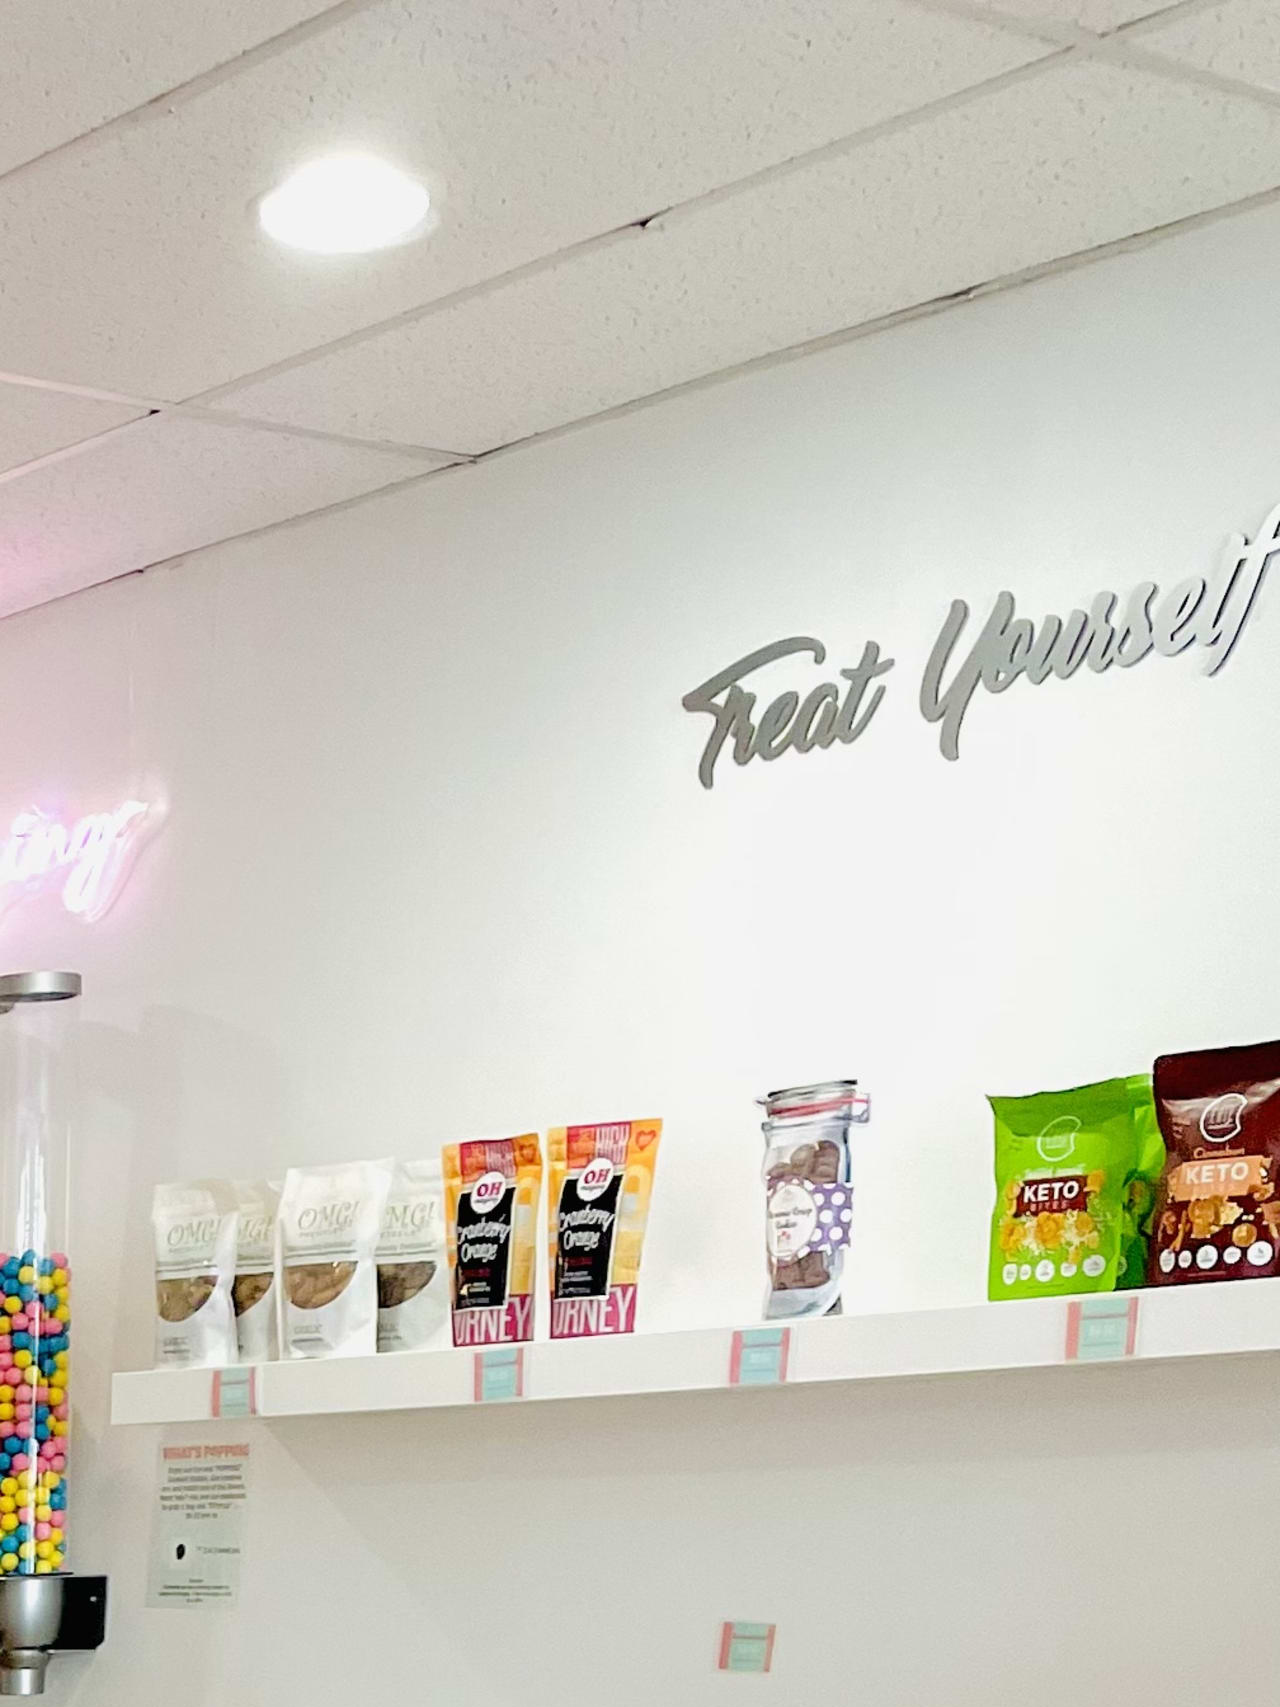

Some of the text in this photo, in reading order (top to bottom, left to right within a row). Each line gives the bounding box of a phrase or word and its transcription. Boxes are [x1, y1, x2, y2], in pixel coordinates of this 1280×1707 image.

[682, 500, 1280, 790] Treat Yourself
[583, 1168, 611, 1185] OH
[1185, 1162, 1248, 1184] KETO
[476, 1181, 503, 1197] OH
[1023, 1180, 1079, 1204] KETO
